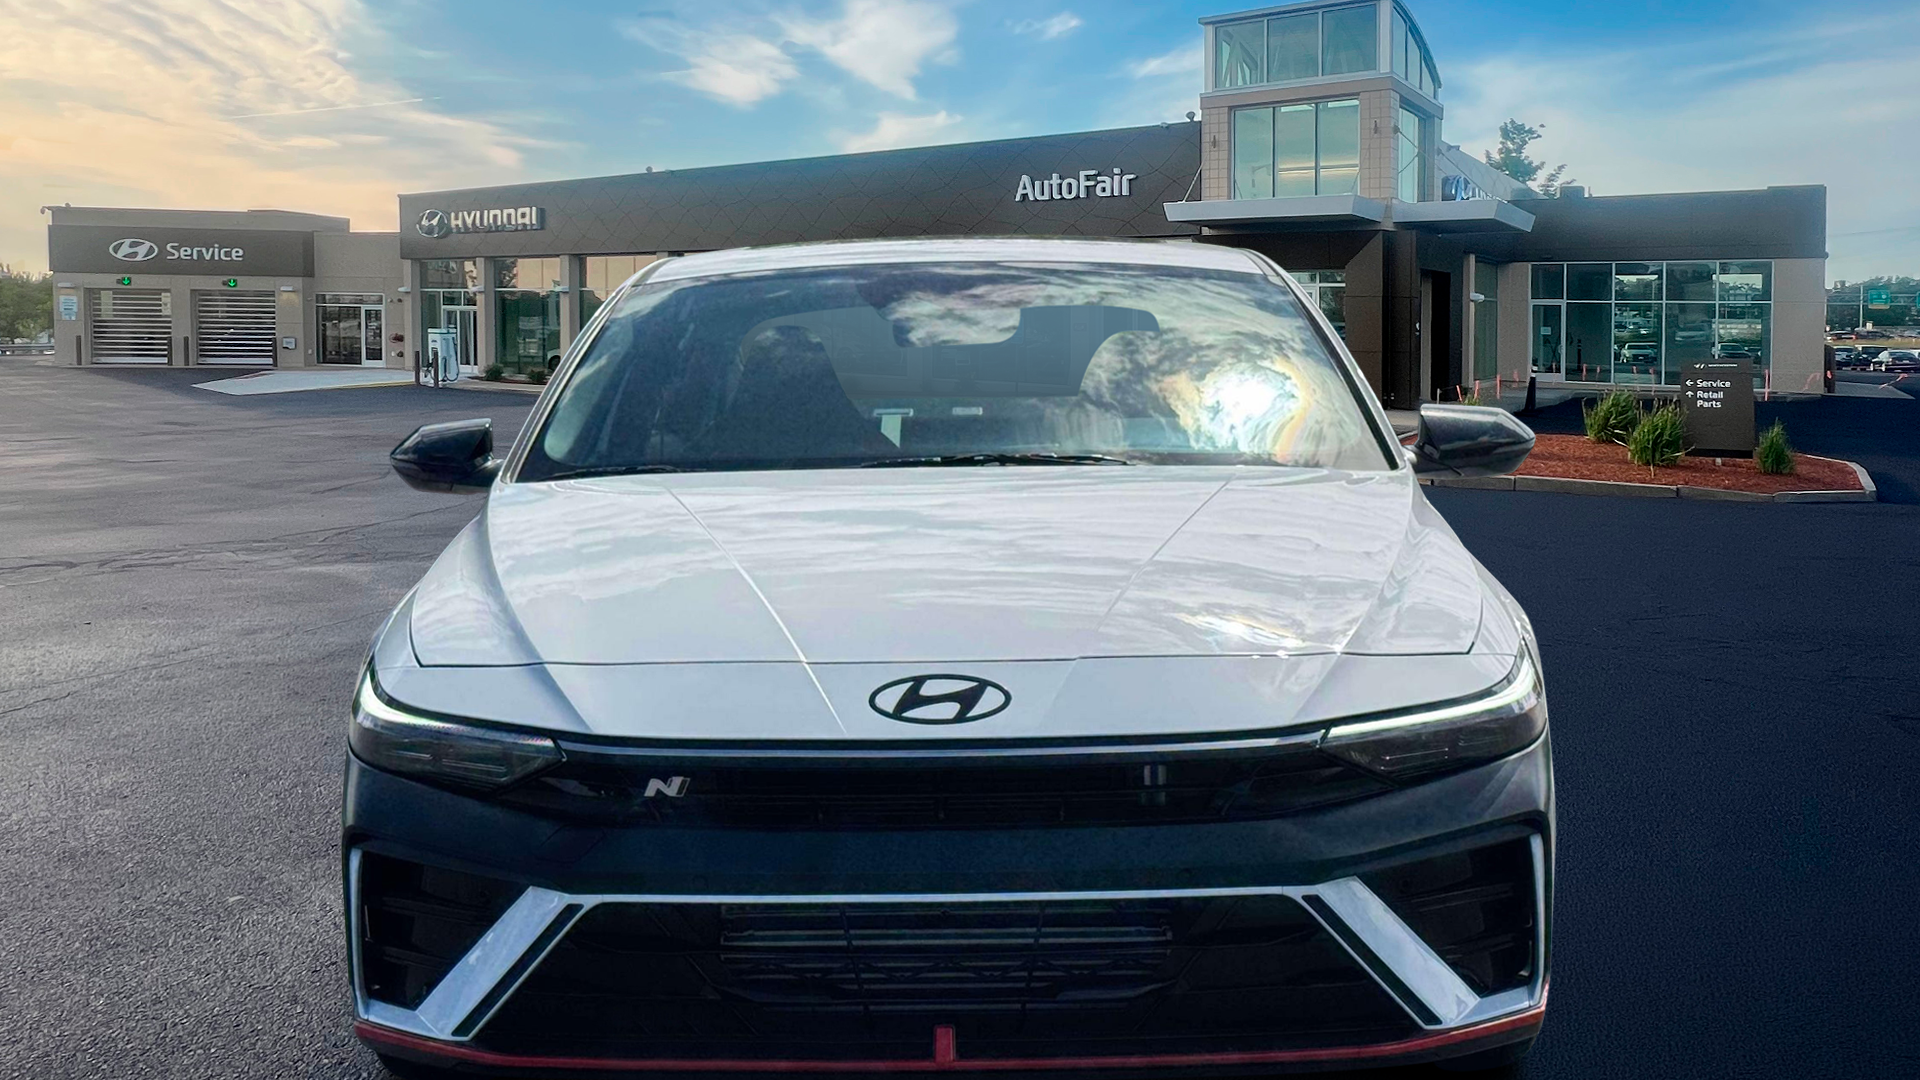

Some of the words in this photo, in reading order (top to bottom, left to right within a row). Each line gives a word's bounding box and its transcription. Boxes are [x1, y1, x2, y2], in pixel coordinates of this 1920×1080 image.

[1015, 168, 1137, 202] AutoFair
[450, 206, 542, 233] HYUNDAI
[166, 243, 244, 261] Service
[1696, 379, 1731, 388] Service
[1696, 390, 1724, 399] Retail
[1696, 400, 1722, 408] Parts
